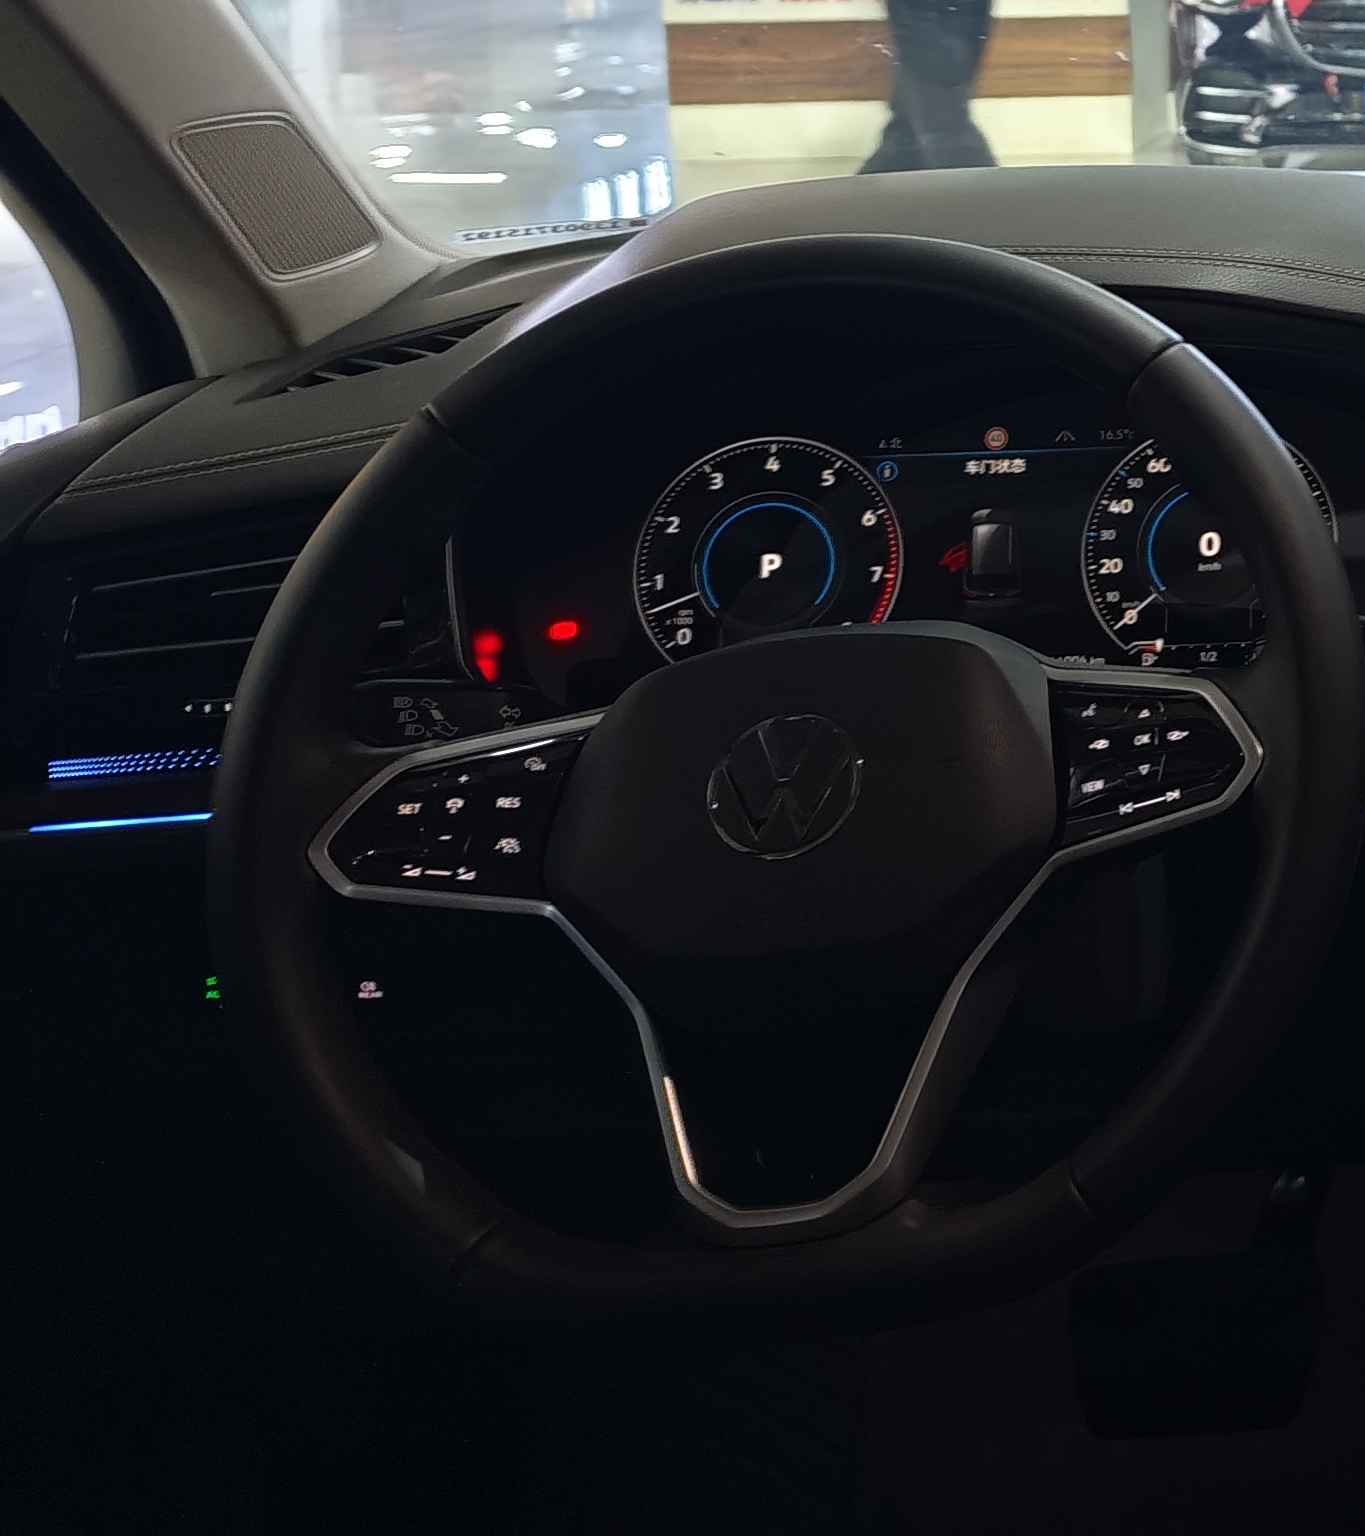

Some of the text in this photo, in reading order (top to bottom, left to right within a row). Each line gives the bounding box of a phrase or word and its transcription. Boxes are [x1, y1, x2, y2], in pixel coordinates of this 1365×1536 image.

[764, 457, 781, 473] 4
[707, 472, 725, 491] 3
[819, 469, 836, 487] 5
[1126, 475, 1145, 490] 50
[1107, 498, 1135, 515] 40
[664, 516, 682, 534] 2
[860, 510, 878, 527] 6
[1099, 528, 1117, 543] 30
[1198, 531, 1224, 559] 0
[758, 552, 784, 580] P
[869, 565, 883, 583] 7
[1099, 557, 1125, 575] 20
[653, 573, 665, 591] 1
[1105, 590, 1121, 603] 10
[675, 628, 692, 645] 0
[1199, 650, 1219, 664] 1/2
[396, 802, 424, 815] SET
[495, 796, 522, 809] RES
